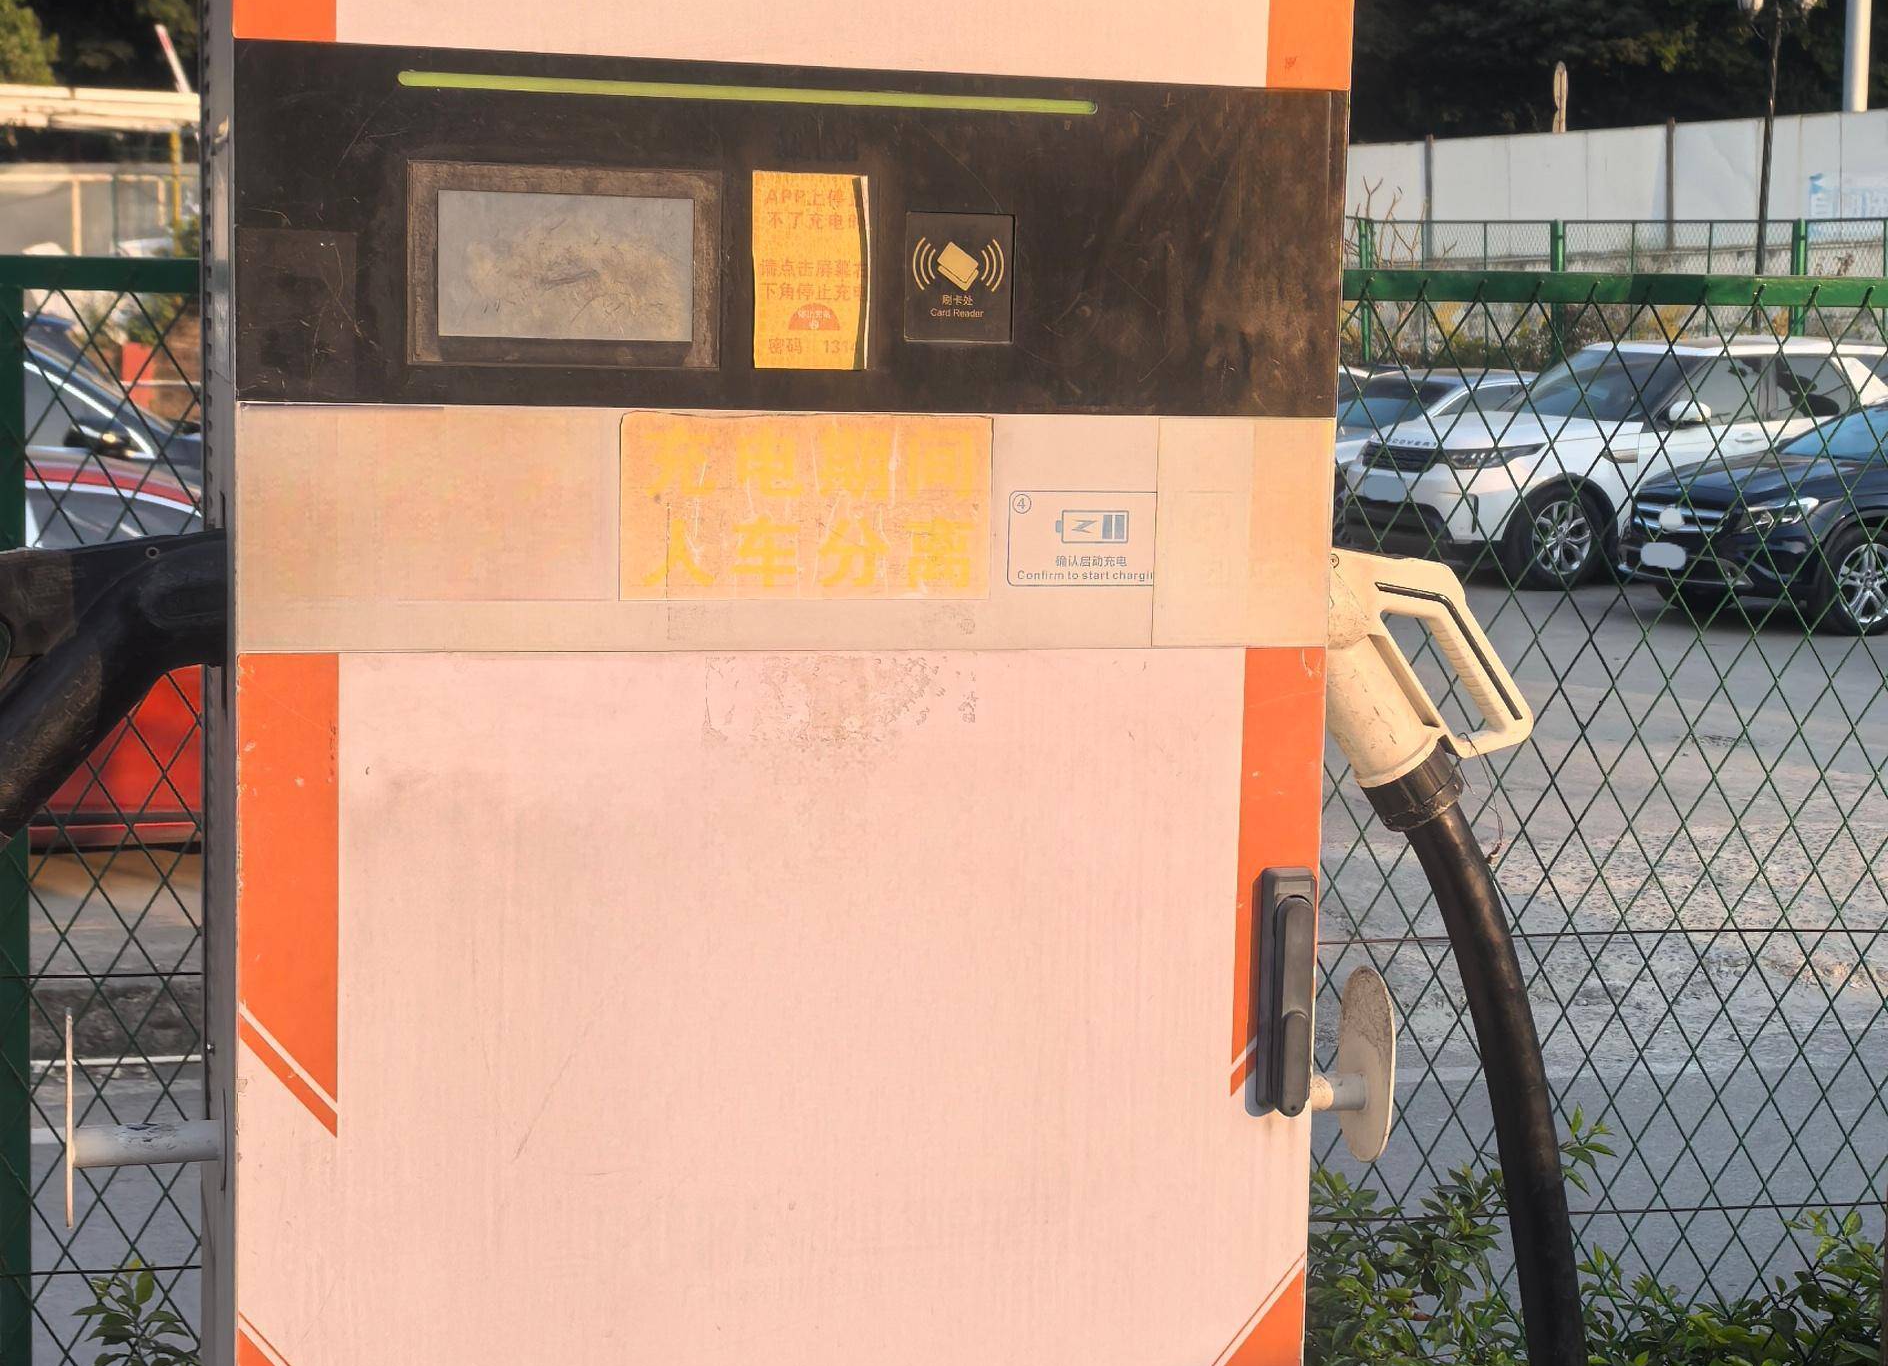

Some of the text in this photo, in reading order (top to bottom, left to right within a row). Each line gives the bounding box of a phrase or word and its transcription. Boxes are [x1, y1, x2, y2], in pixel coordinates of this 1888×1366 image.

[942, 294, 973, 306] 刷卡处
[930, 307, 984, 318] Card Reader
[643, 427, 973, 498] 充电期间
[642, 516, 973, 589] 人车分离
[1055, 555, 1127, 567] 确认启动充电
[1017, 570, 1064, 580] Confirm
[1067, 570, 1079, 580] to
[1081, 570, 1109, 580] start
